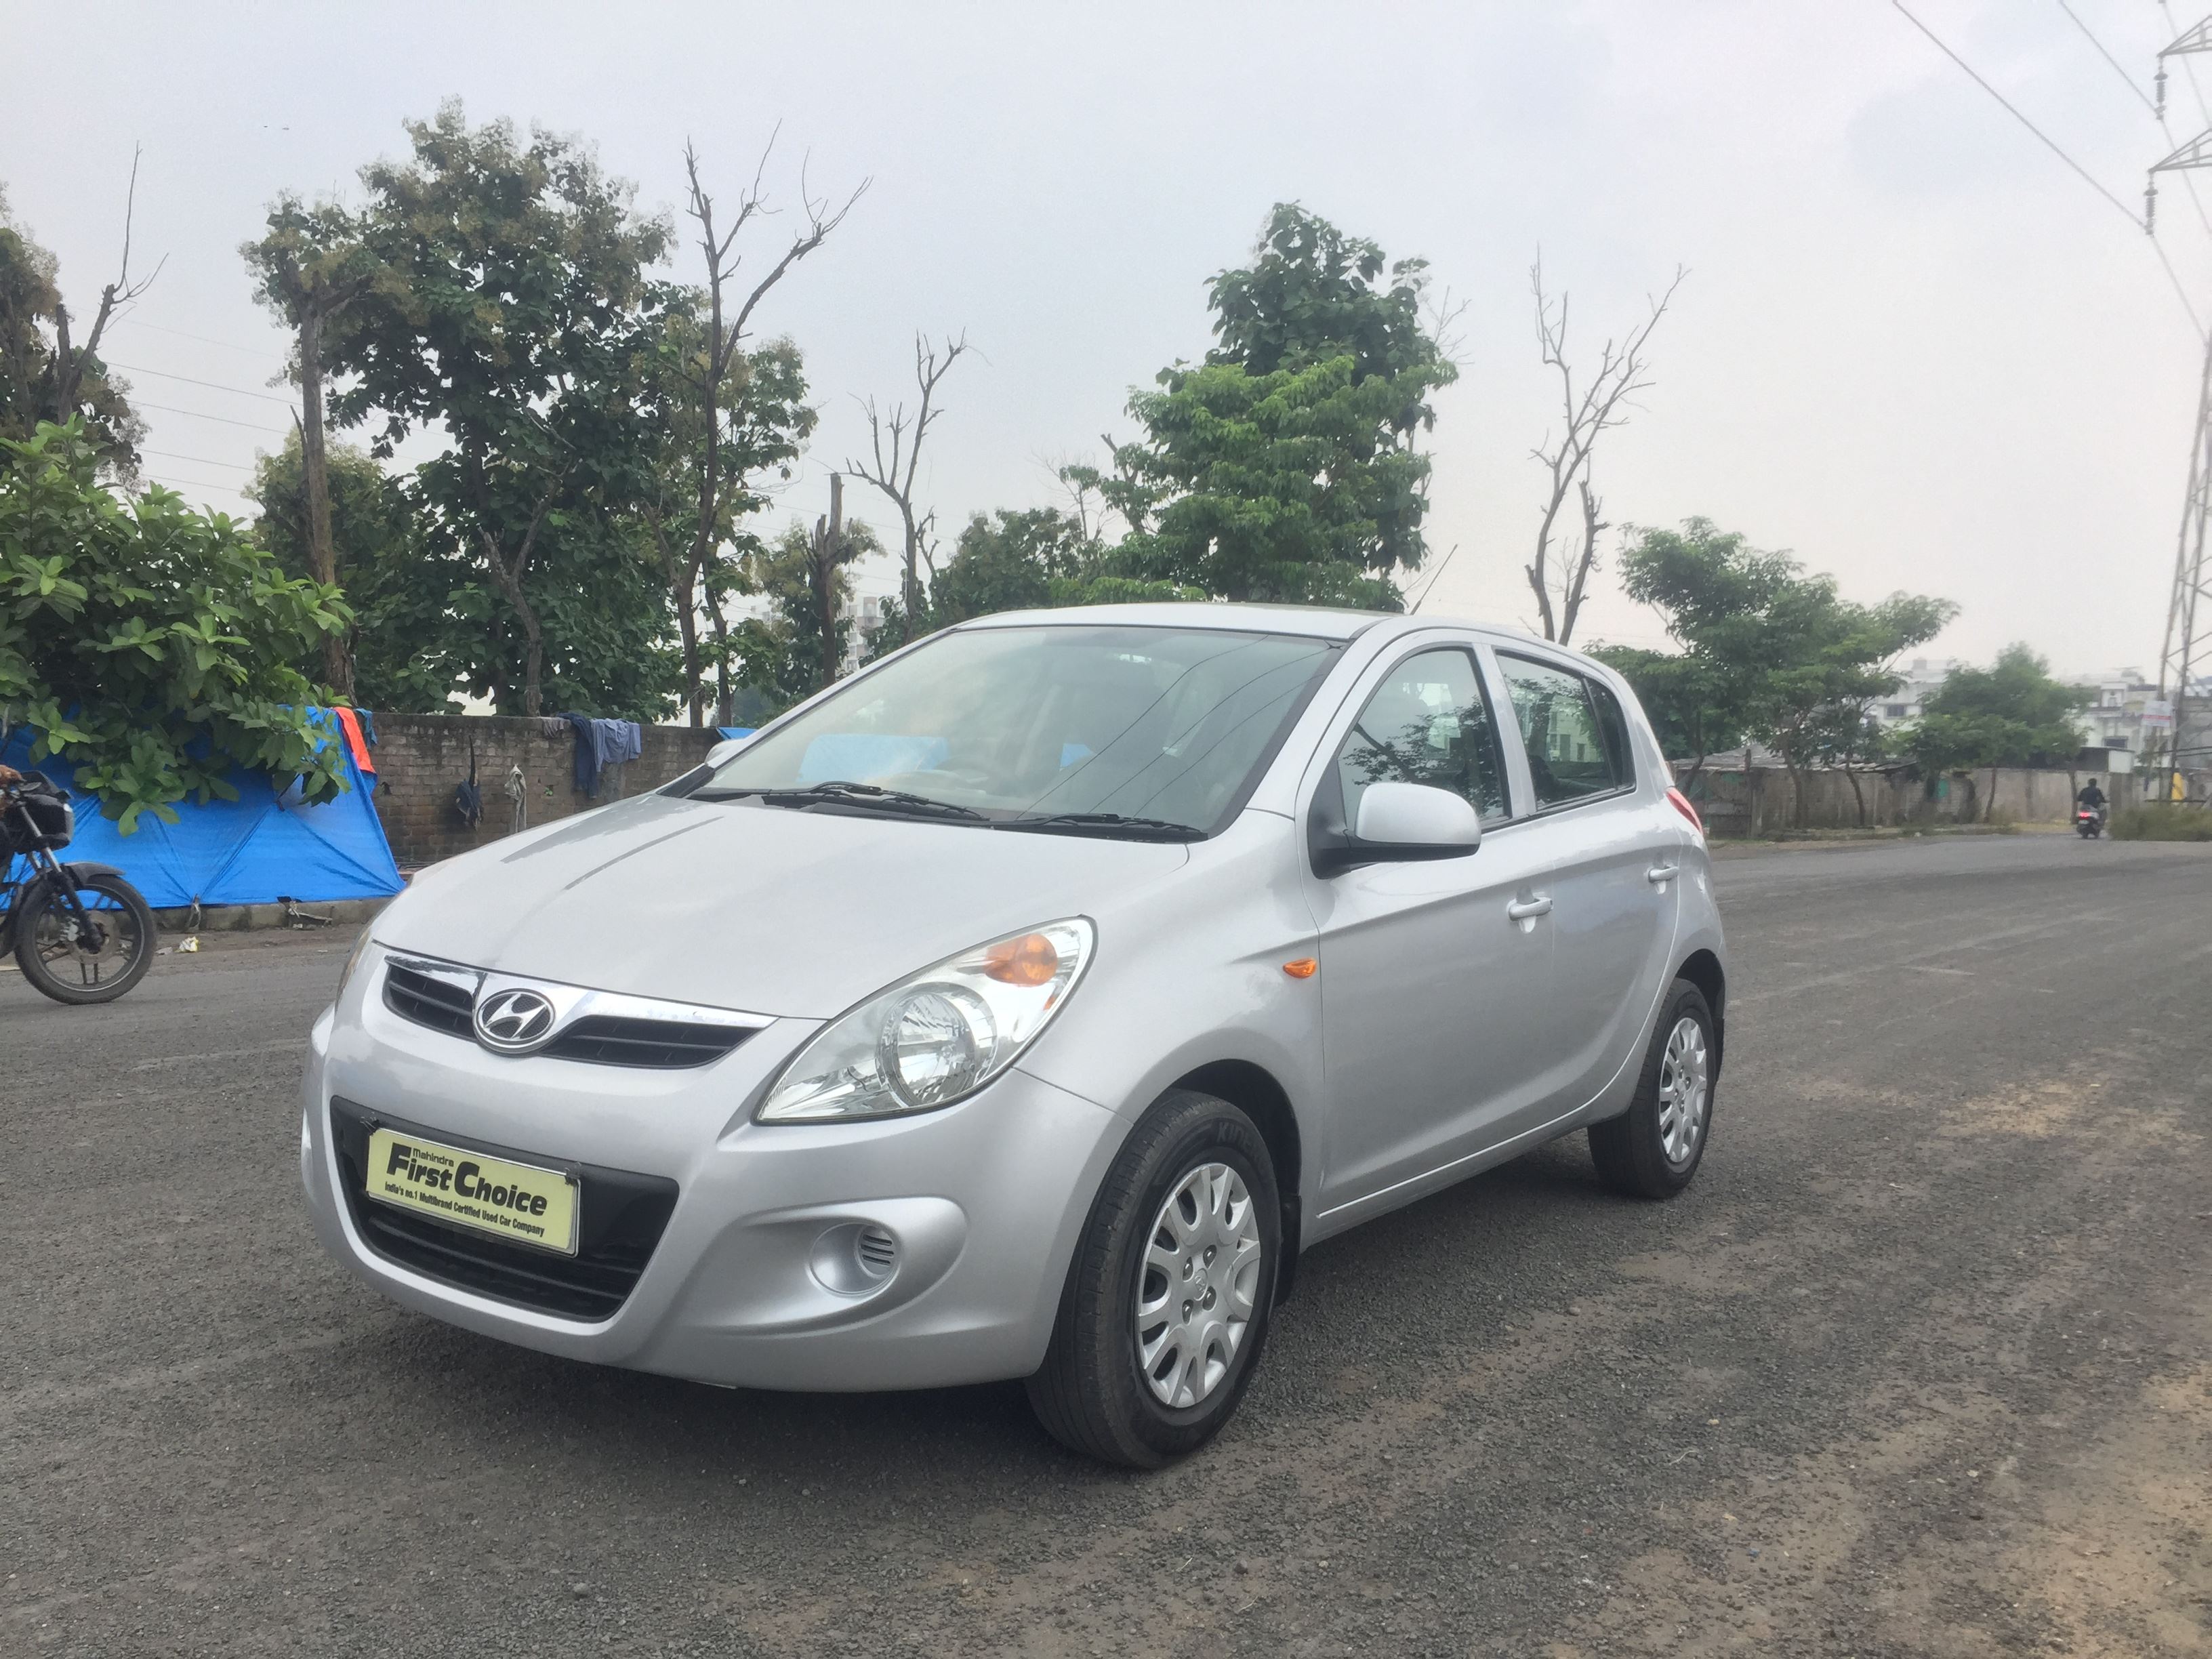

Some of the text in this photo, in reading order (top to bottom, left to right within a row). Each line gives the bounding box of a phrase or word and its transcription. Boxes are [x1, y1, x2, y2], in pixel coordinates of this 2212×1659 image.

[413, 1147, 455, 1168] Mahindra
[384, 1181, 405, 1196] India's
[419, 1191, 453, 1210] Multibrand
[453, 1201, 481, 1218] Certified
[482, 1210, 499, 1223] Used
[499, 1214, 512, 1227] Car
[512, 1218, 545, 1237] Company
